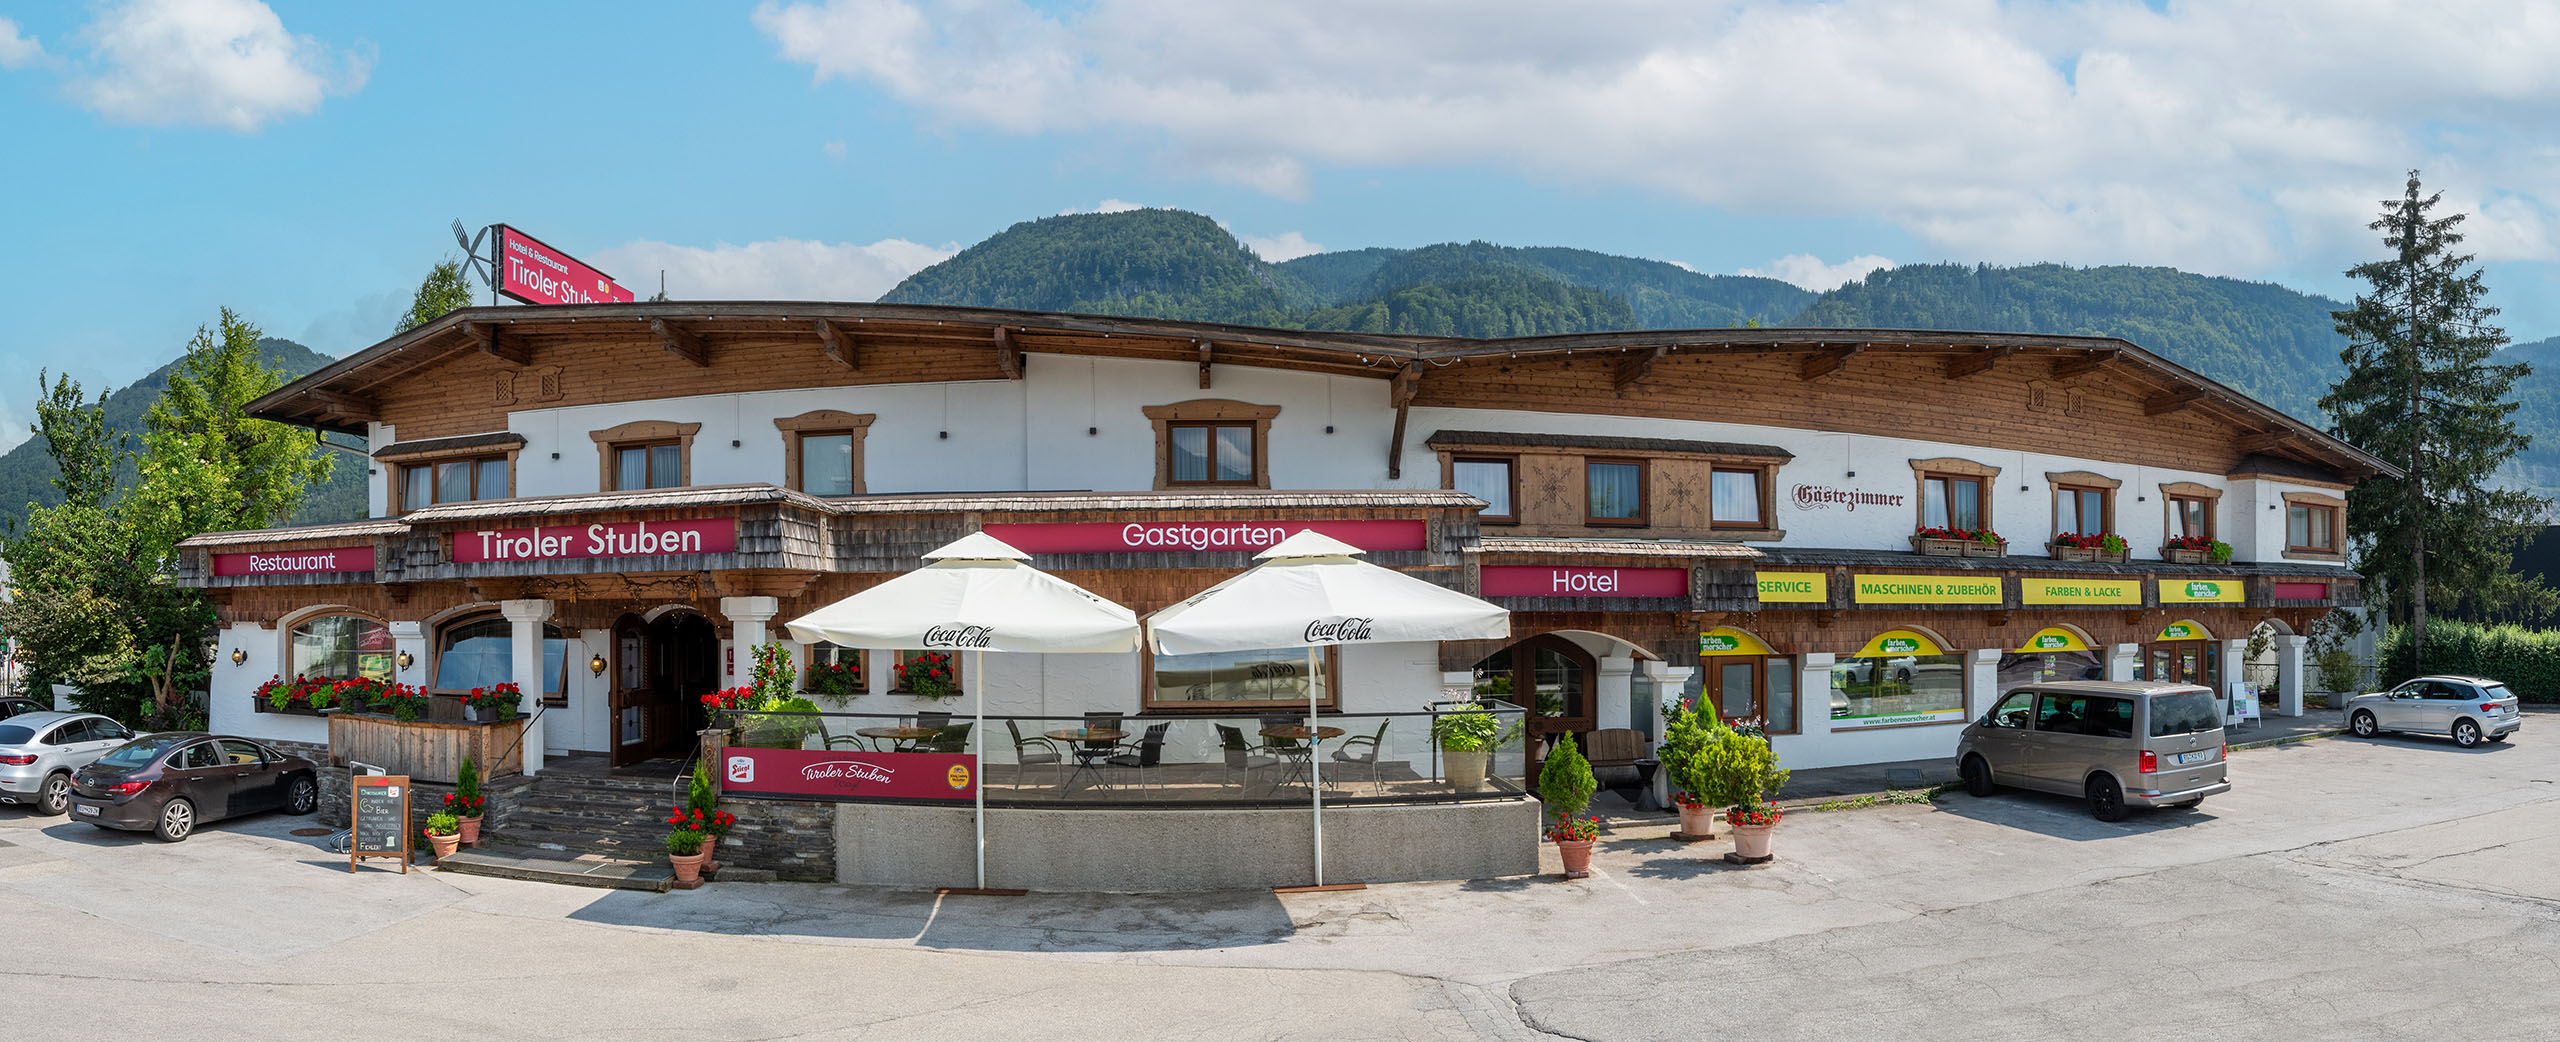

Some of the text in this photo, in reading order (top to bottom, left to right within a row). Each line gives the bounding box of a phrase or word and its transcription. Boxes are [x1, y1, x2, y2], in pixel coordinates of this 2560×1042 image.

[509, 238, 569, 275] Hotel & Restaurant
[509, 256, 600, 304] Tiroler Stub
[1792, 482, 1904, 512] Gästezimmer
[477, 521, 701, 560] Tiroler Stuben
[1122, 522, 1286, 551] Gastgarten
[250, 552, 336, 572] Restaurant
[1553, 569, 1618, 592] Hotel
[1758, 580, 1812, 593] SERVICE
[1860, 583, 1997, 596] MASCHINEN & ZUBEHÖR
[2045, 586, 2122, 597] FARBEN & LACKE
[922, 624, 996, 648] Coca-Cola
[1304, 617, 1375, 643] Coca-Cola
[1700, 635, 1722, 645] farben
[1703, 642, 1733, 652] morscher
[1887, 638, 1906, 646] farben
[1889, 643, 1915, 652] morscher
[1863, 714, 1936, 726] www.farbenmorscher.at
[803, 763, 892, 785] Tiroler Stuben
